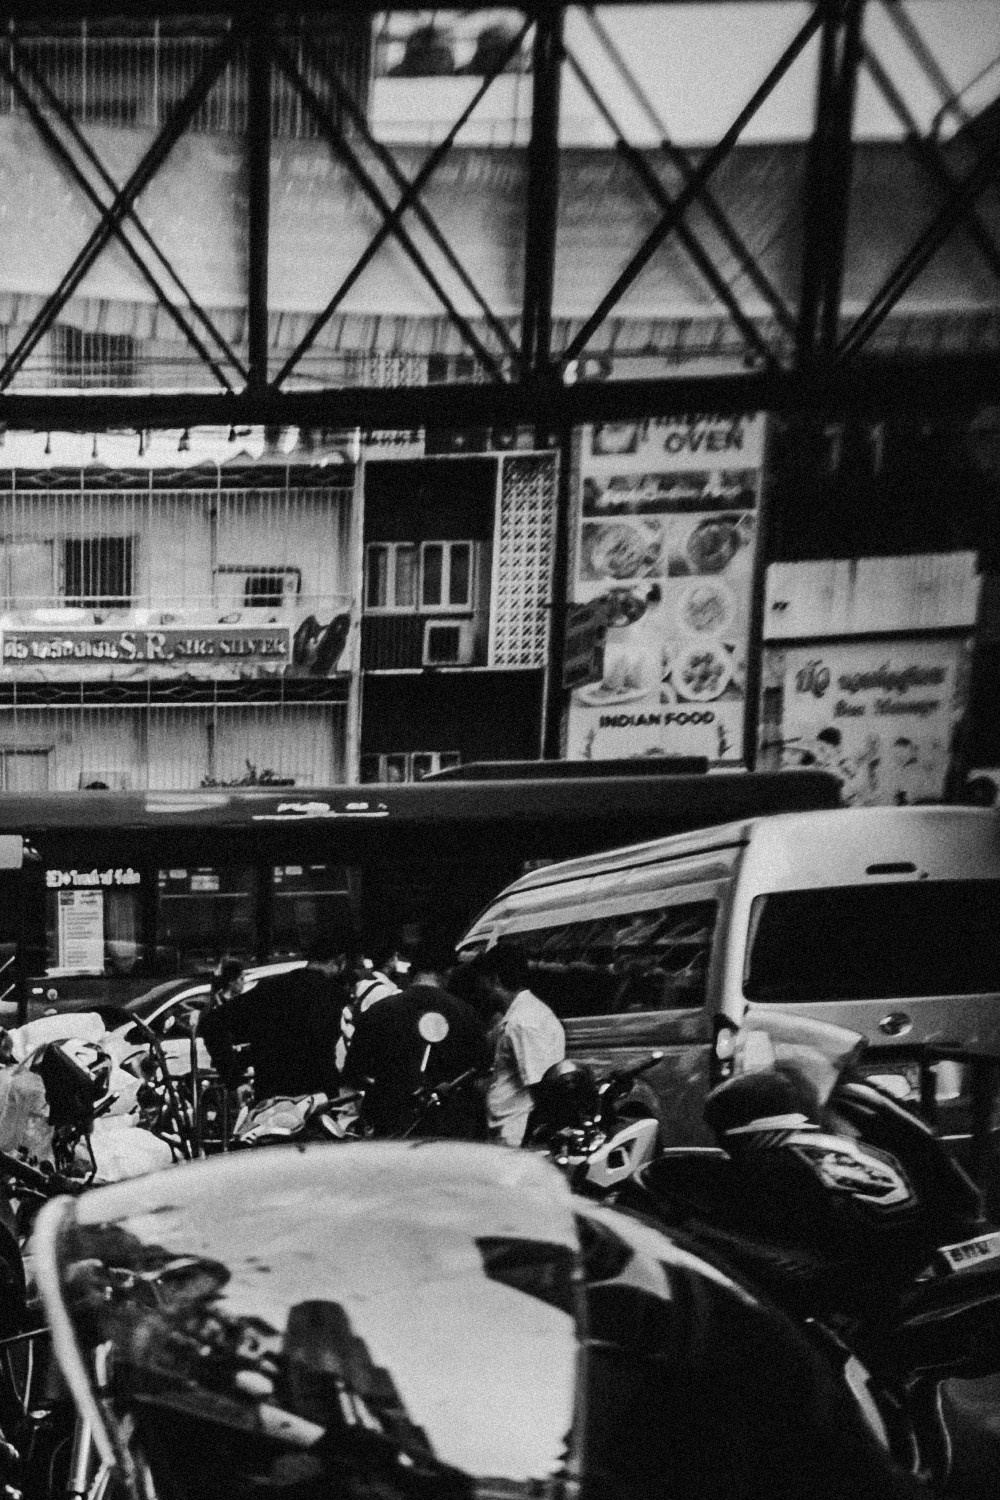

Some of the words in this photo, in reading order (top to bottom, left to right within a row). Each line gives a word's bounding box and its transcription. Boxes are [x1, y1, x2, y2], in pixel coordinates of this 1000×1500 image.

[663, 429, 745, 453] OVEN
[599, 713, 661, 728] INDIAN
[664, 711, 715, 726] FOOD
